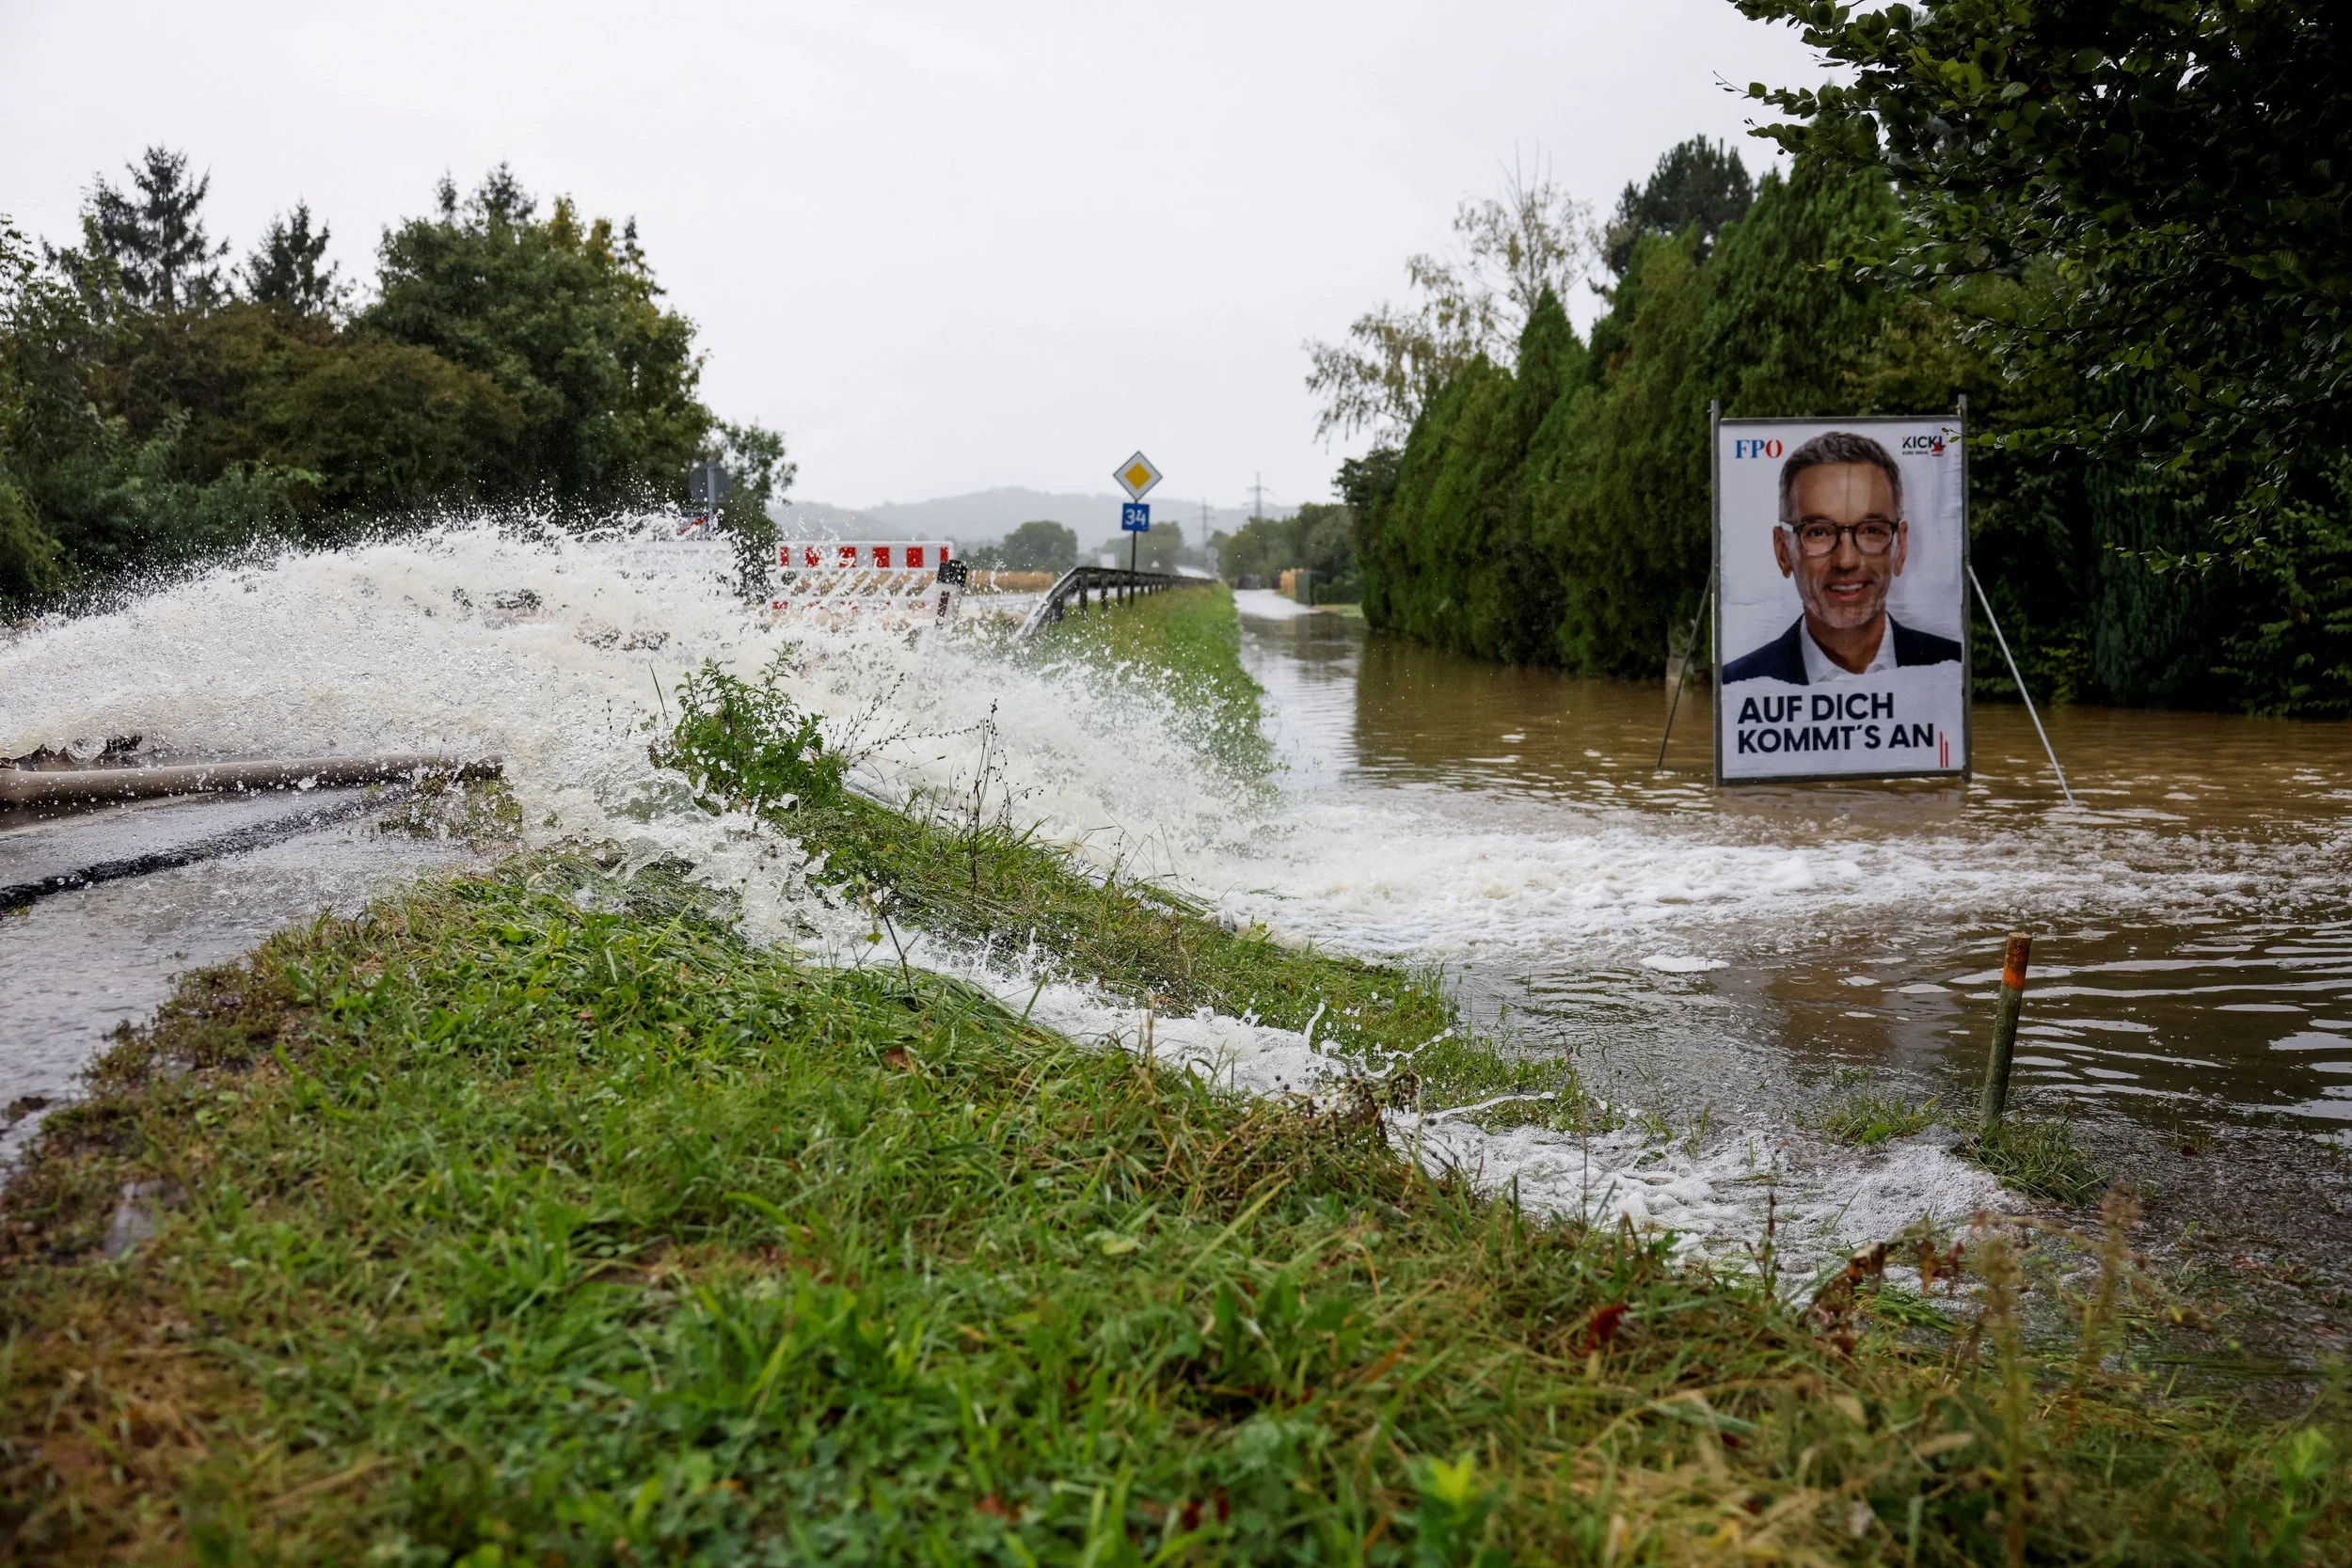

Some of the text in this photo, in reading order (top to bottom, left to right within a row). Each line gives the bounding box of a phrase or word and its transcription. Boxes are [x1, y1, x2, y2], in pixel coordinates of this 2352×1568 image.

[1902, 436, 1946, 449] KICKL
[1125, 508, 1146, 526] 34
[1738, 692, 1894, 723] AUF DICH
[1888, 723, 1934, 749] AN
